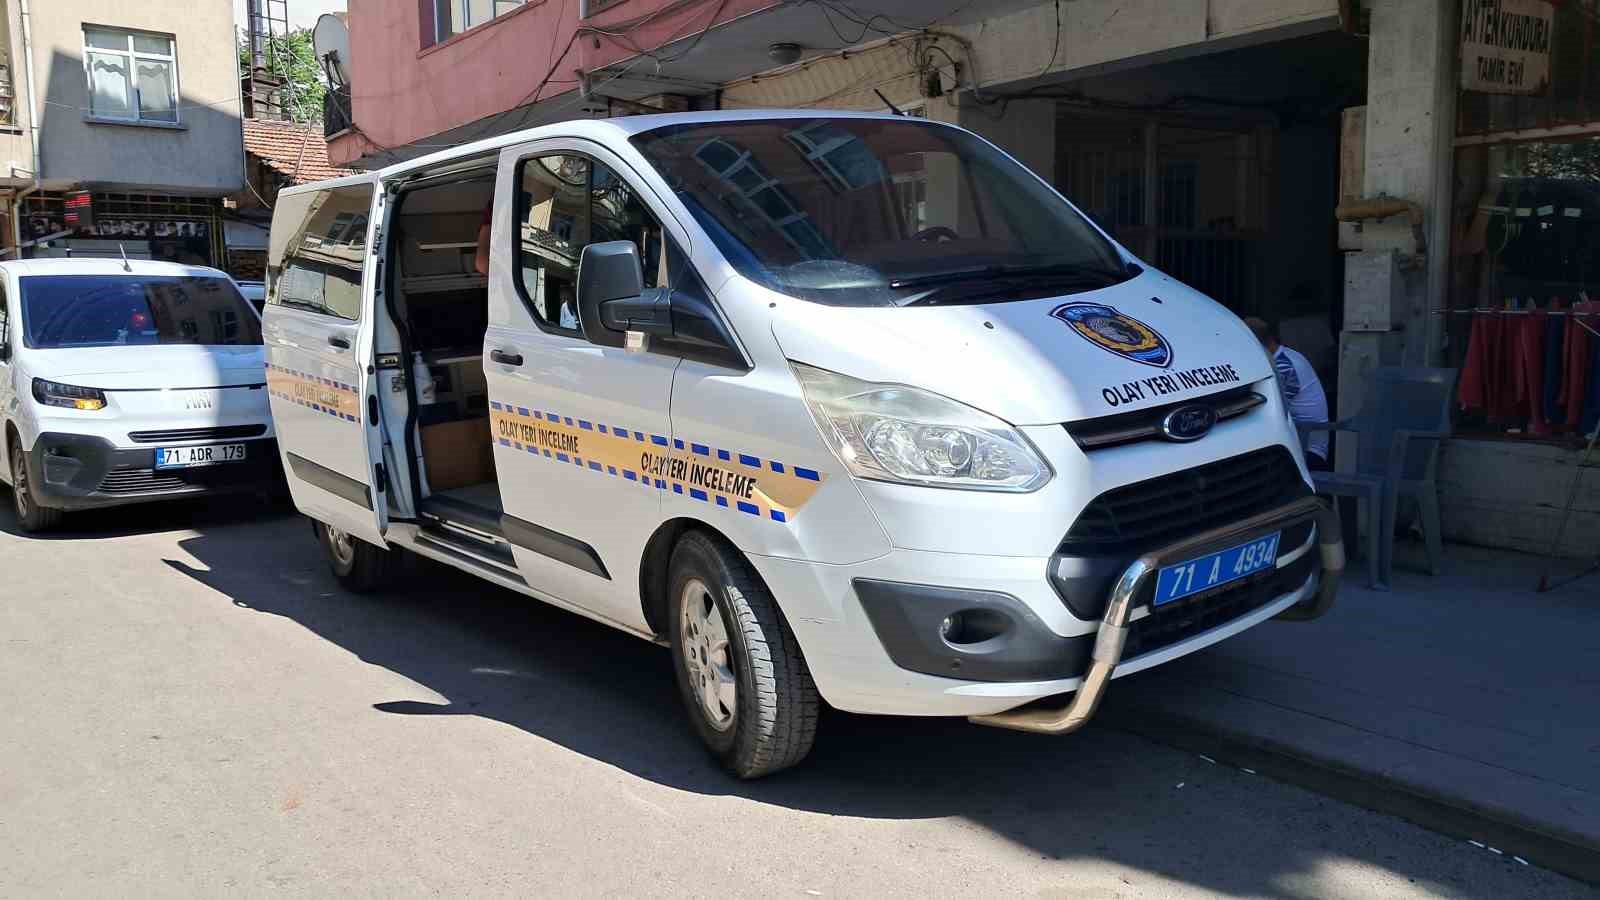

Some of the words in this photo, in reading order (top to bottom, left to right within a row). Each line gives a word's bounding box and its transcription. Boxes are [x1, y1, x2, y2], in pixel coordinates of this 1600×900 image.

[1500, 11, 1552, 54] KUNDURA
[1102, 382, 1145, 406] OLAY
[165, 450, 180, 463] 71
[190, 448, 213, 461] ADR
[222, 446, 244, 460] 179
[500, 419, 519, 438] OLAY
[519, 423, 537, 443] YERİ
[538, 424, 579, 453] İNCELEME
[641, 452, 667, 477] OLAY
[666, 456, 689, 480] YERİ
[689, 458, 757, 499] İNCELEME
[1170, 564, 1196, 597] 71
[1207, 556, 1221, 585] A
[1233, 538, 1276, 574] 4934
